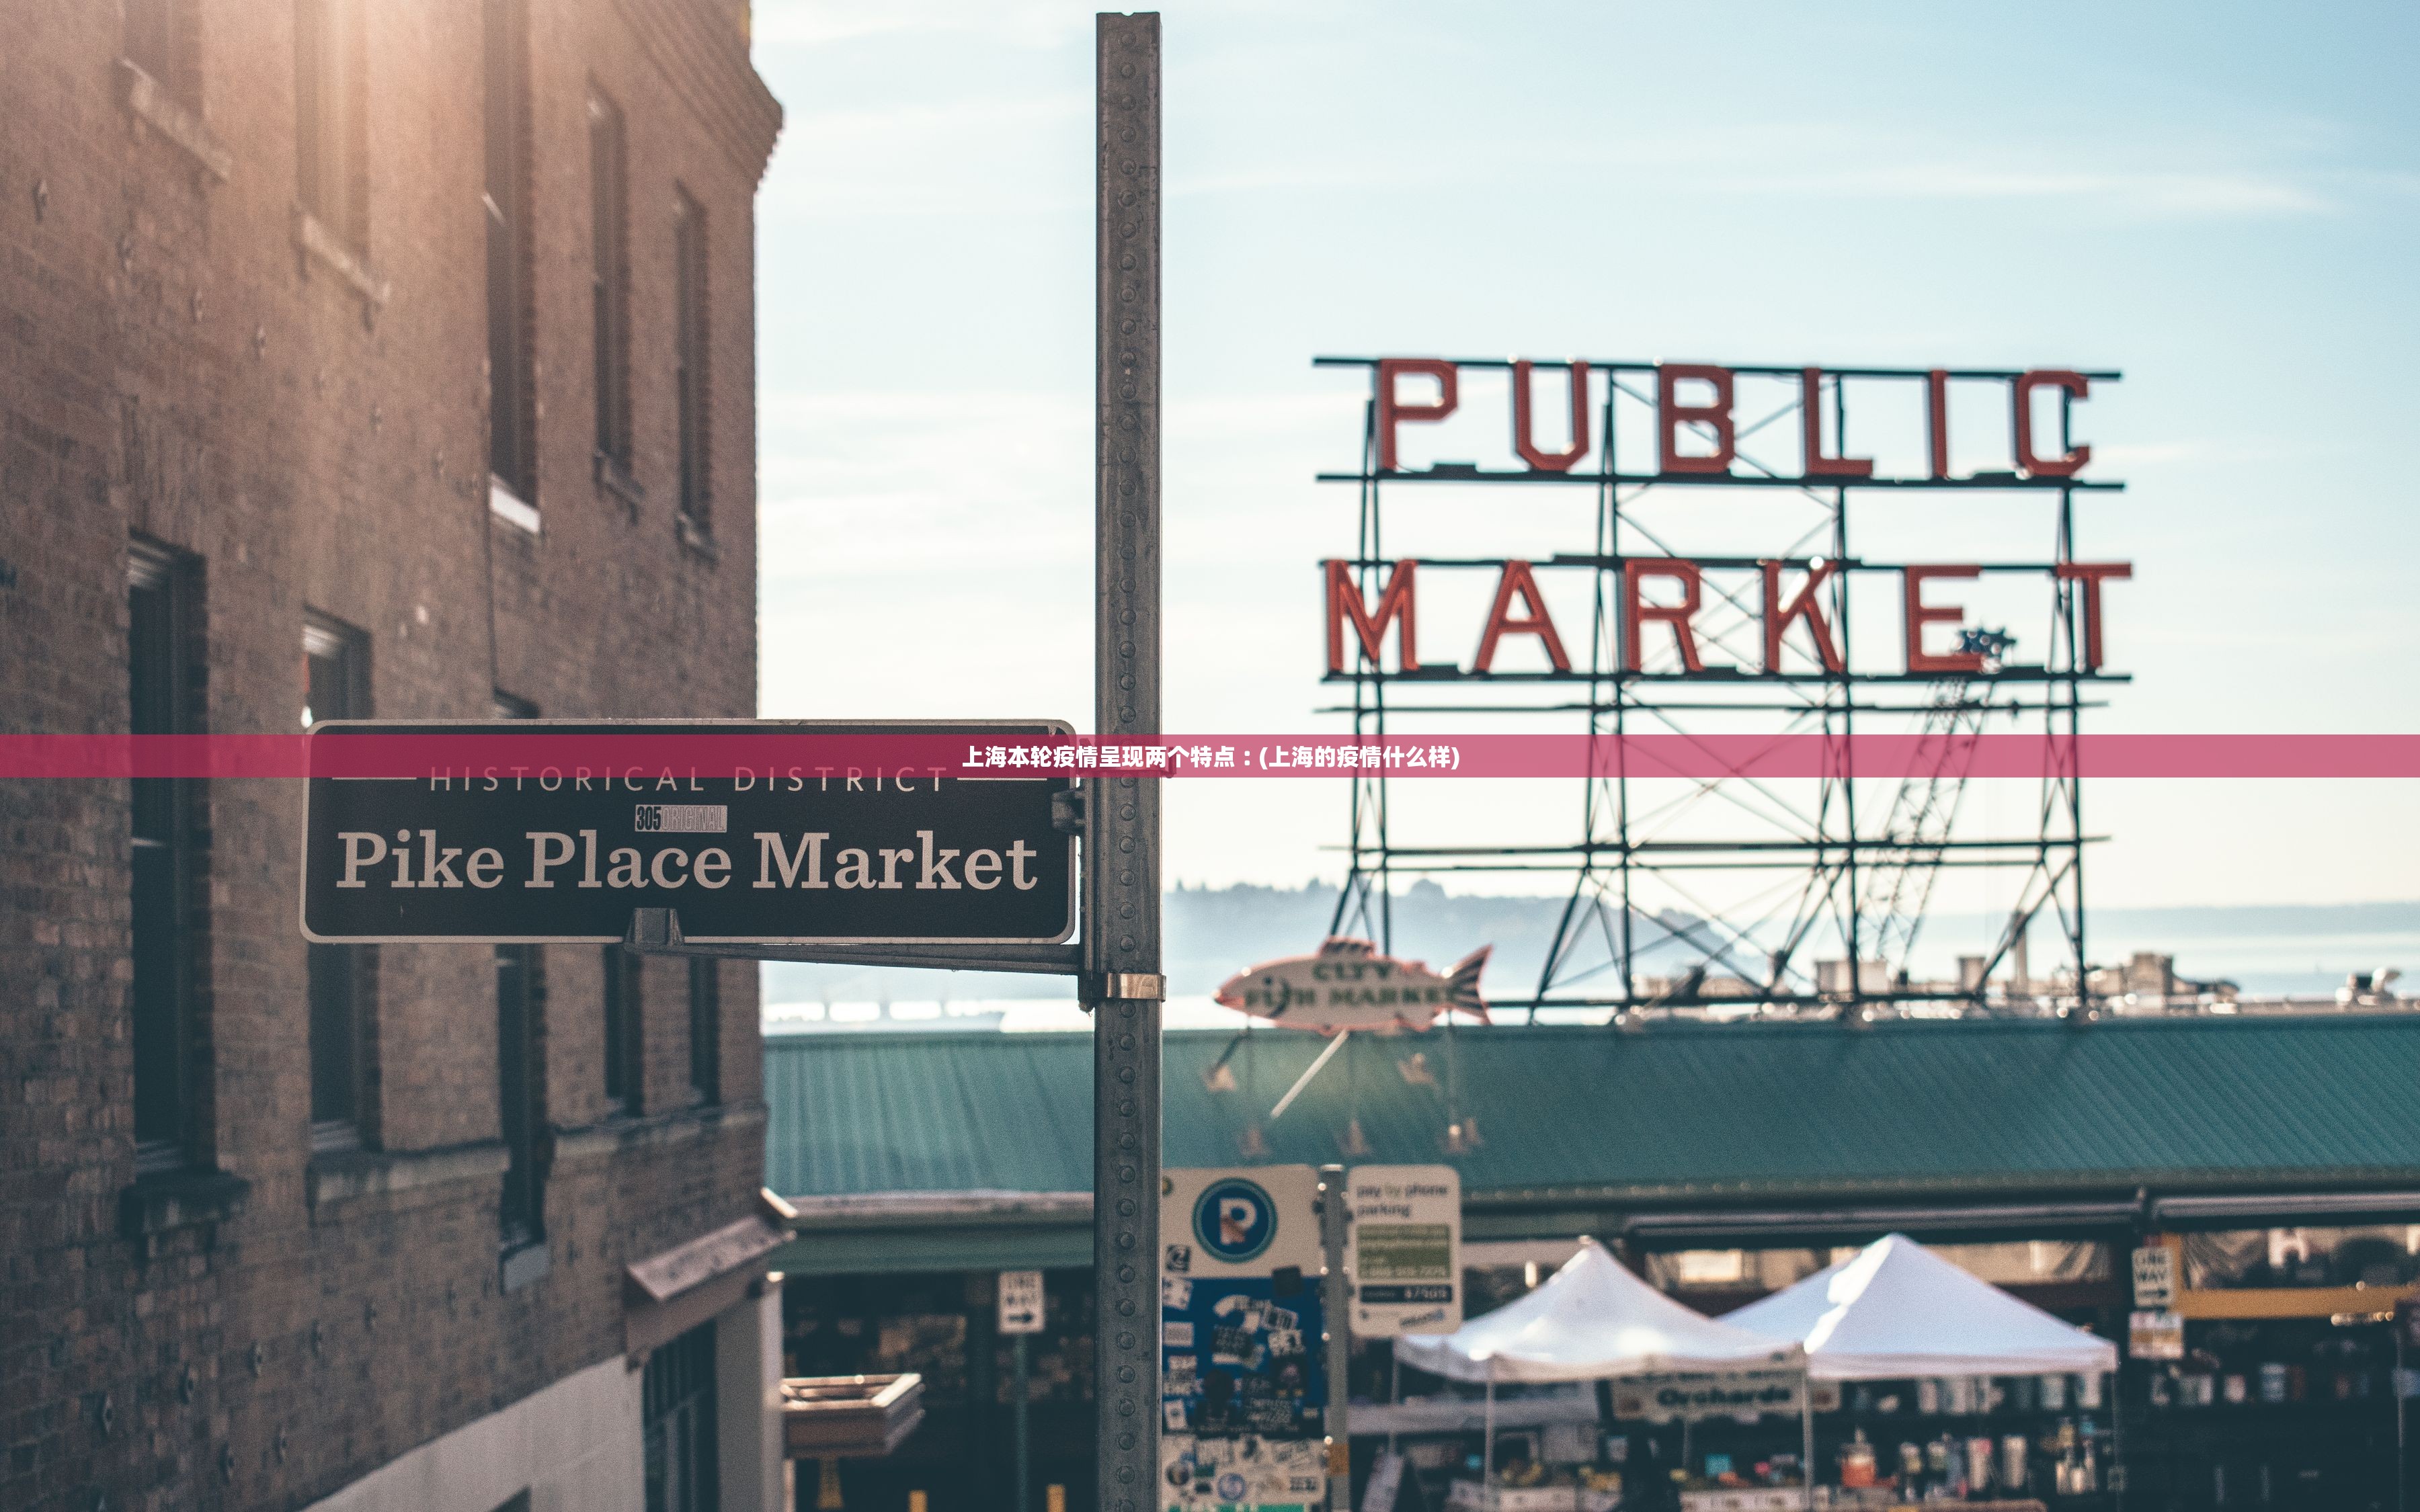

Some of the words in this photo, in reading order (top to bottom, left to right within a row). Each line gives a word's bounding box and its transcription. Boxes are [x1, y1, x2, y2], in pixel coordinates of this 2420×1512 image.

[1377, 358, 2091, 477] PUBLIC
[1324, 558, 2133, 673] MARKET
[430, 766, 704, 792] HISTORICAL
[734, 767, 946, 792] DISTRICT
[336, 829, 504, 888] Pike
[524, 829, 732, 888] Place
[752, 830, 1039, 890] Market
[1314, 961, 1392, 982] CITY
